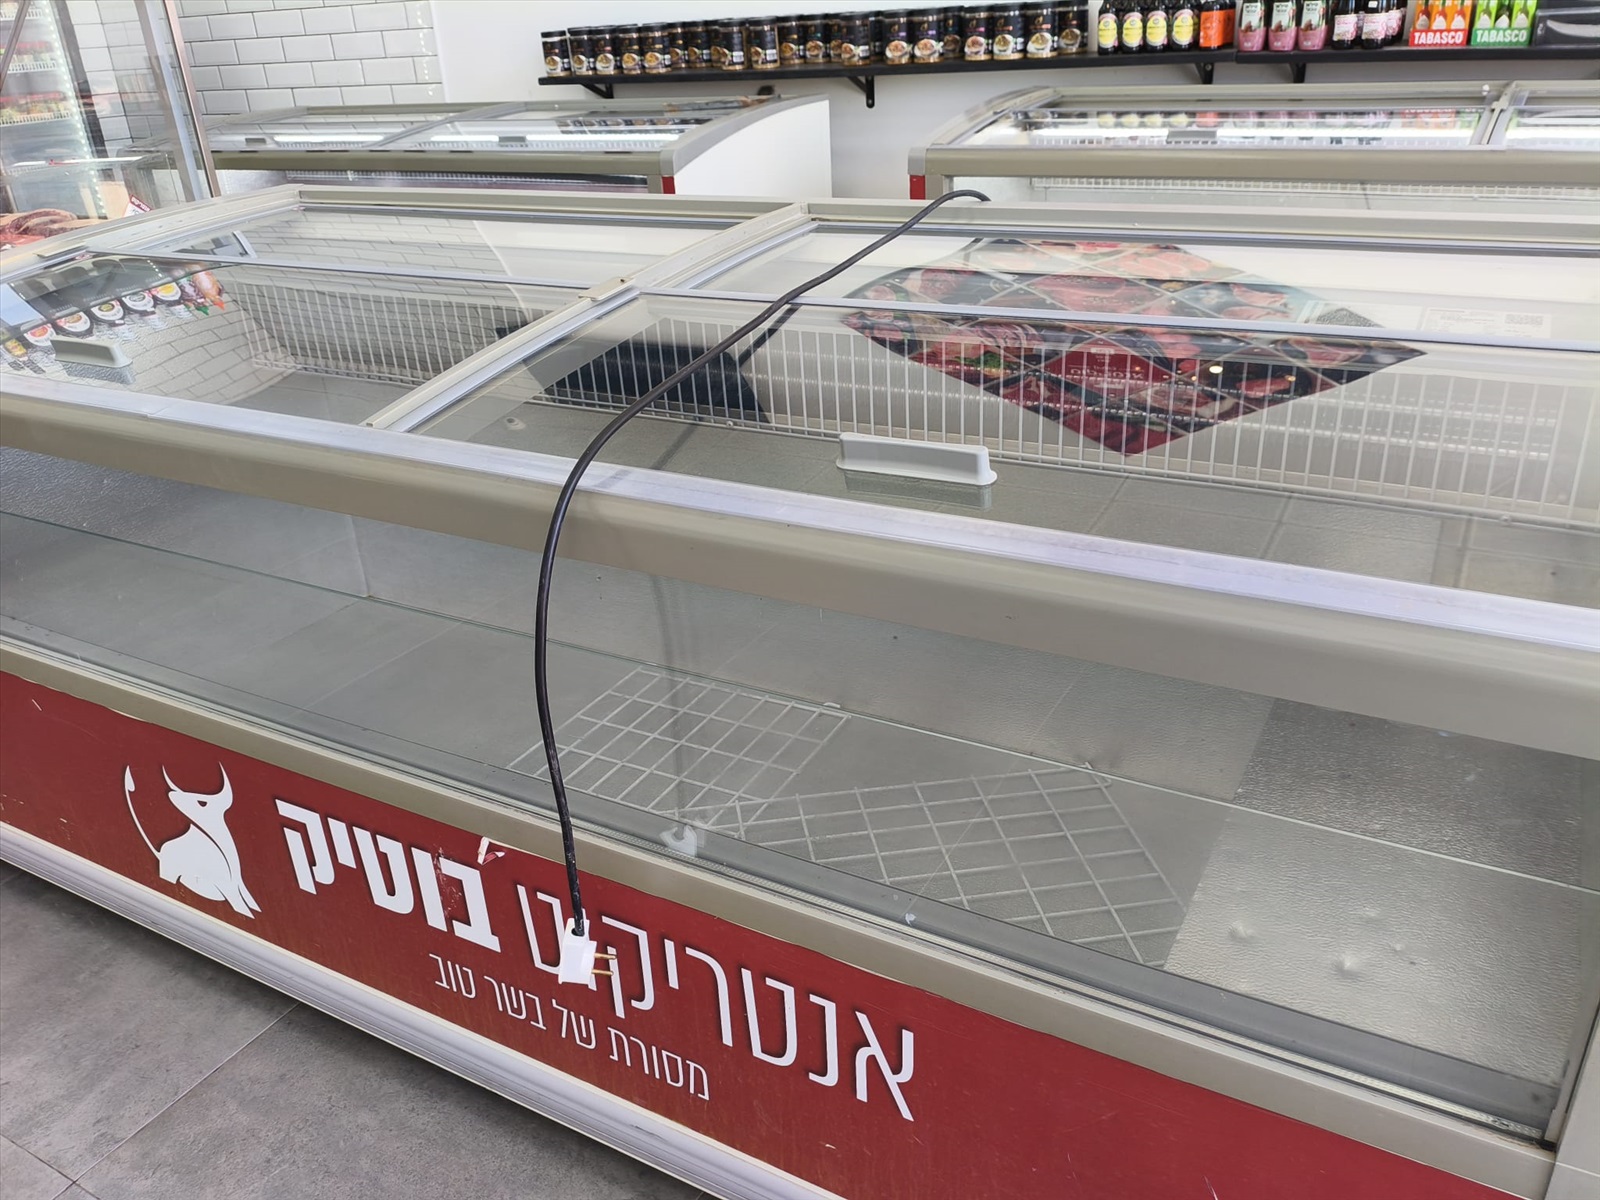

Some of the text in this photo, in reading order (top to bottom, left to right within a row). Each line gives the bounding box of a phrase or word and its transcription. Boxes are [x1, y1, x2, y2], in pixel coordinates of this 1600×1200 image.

[1413, 30, 1464, 45] TABASCO
[1475, 29, 1528, 43] TABASCO
[275, 799, 914, 1121] אנטריקט בוטיק
[428, 953, 710, 1101] מסורת של בשר טוב
